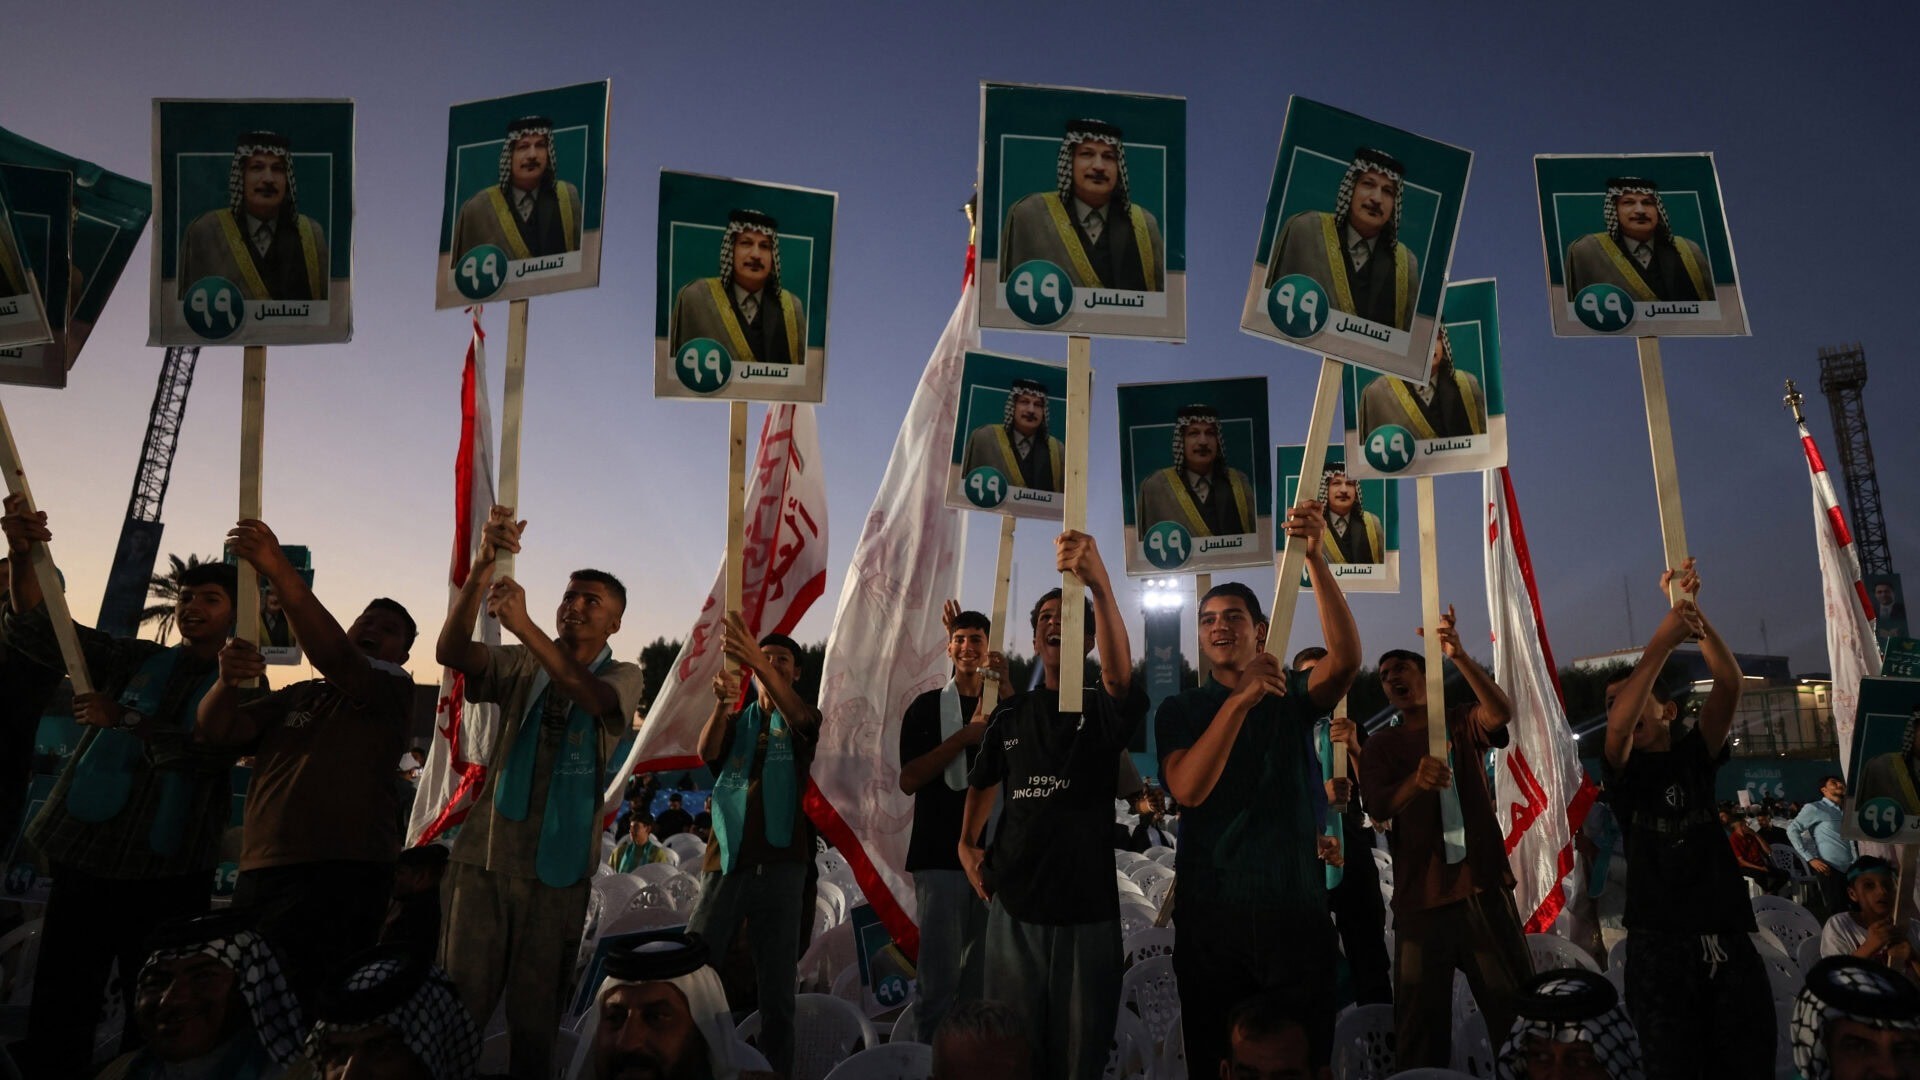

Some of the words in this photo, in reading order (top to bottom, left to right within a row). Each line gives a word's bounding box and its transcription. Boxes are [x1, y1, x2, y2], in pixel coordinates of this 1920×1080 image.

[462, 253, 500, 291] ٩٩
[516, 257, 563, 278] تسلسل
[1015, 271, 1063, 315] ٩٩
[1085, 292, 1144, 309] تسلسل
[190, 287, 237, 328] ٩٩
[255, 304, 309, 321] تسلسل
[1276, 283, 1320, 331] ٩٩
[1582, 292, 1627, 324] ٩٩
[1645, 304, 1699, 318] تسلسل
[1336, 316, 1391, 343] تسلسل
[683, 348, 724, 385] ٩٩
[741, 365, 788, 379] تسلسل
[1371, 433, 1409, 465] ٩٩
[1424, 439, 1471, 455] تسلسل
[971, 473, 1001, 503] ٩٩
[1014, 489, 1052, 503] تسلسل
[1149, 530, 1186, 562] ٩٩
[1200, 536, 1243, 552] تسلسل
[1336, 566, 1372, 577] تسلسل
[1028, 775, 1057, 786] 1999
[1864, 804, 1896, 832] ٩٩
[880, 979, 904, 1001] ٩٩
